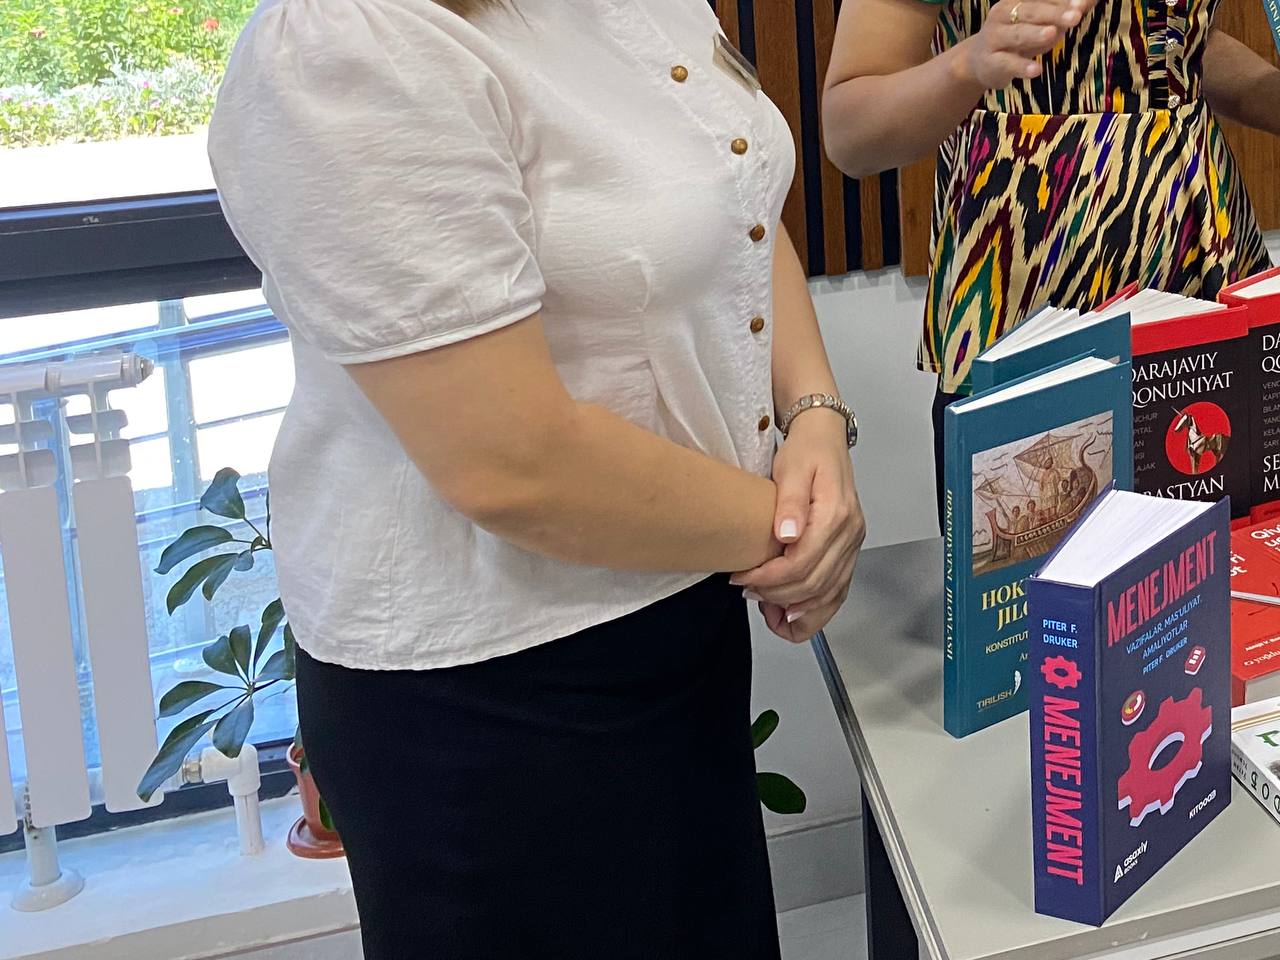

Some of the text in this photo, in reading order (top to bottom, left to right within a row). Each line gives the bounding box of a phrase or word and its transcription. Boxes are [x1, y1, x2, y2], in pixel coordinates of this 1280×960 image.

[1264, 439, 1279, 448] SARI
[1107, 530, 1217, 647] MENEJMENT
[1042, 618, 1077, 633] PITER F.
[1043, 634, 1078, 648] DRUKER
[1142, 620, 1188, 659] AMALIYOTLAR
[1142, 637, 1188, 675] PITER DRUKER
[976, 690, 1012, 709] TIRILISH
[1043, 696, 1083, 885] MENEJMENT
[1124, 841, 1148, 866] asaxiy
